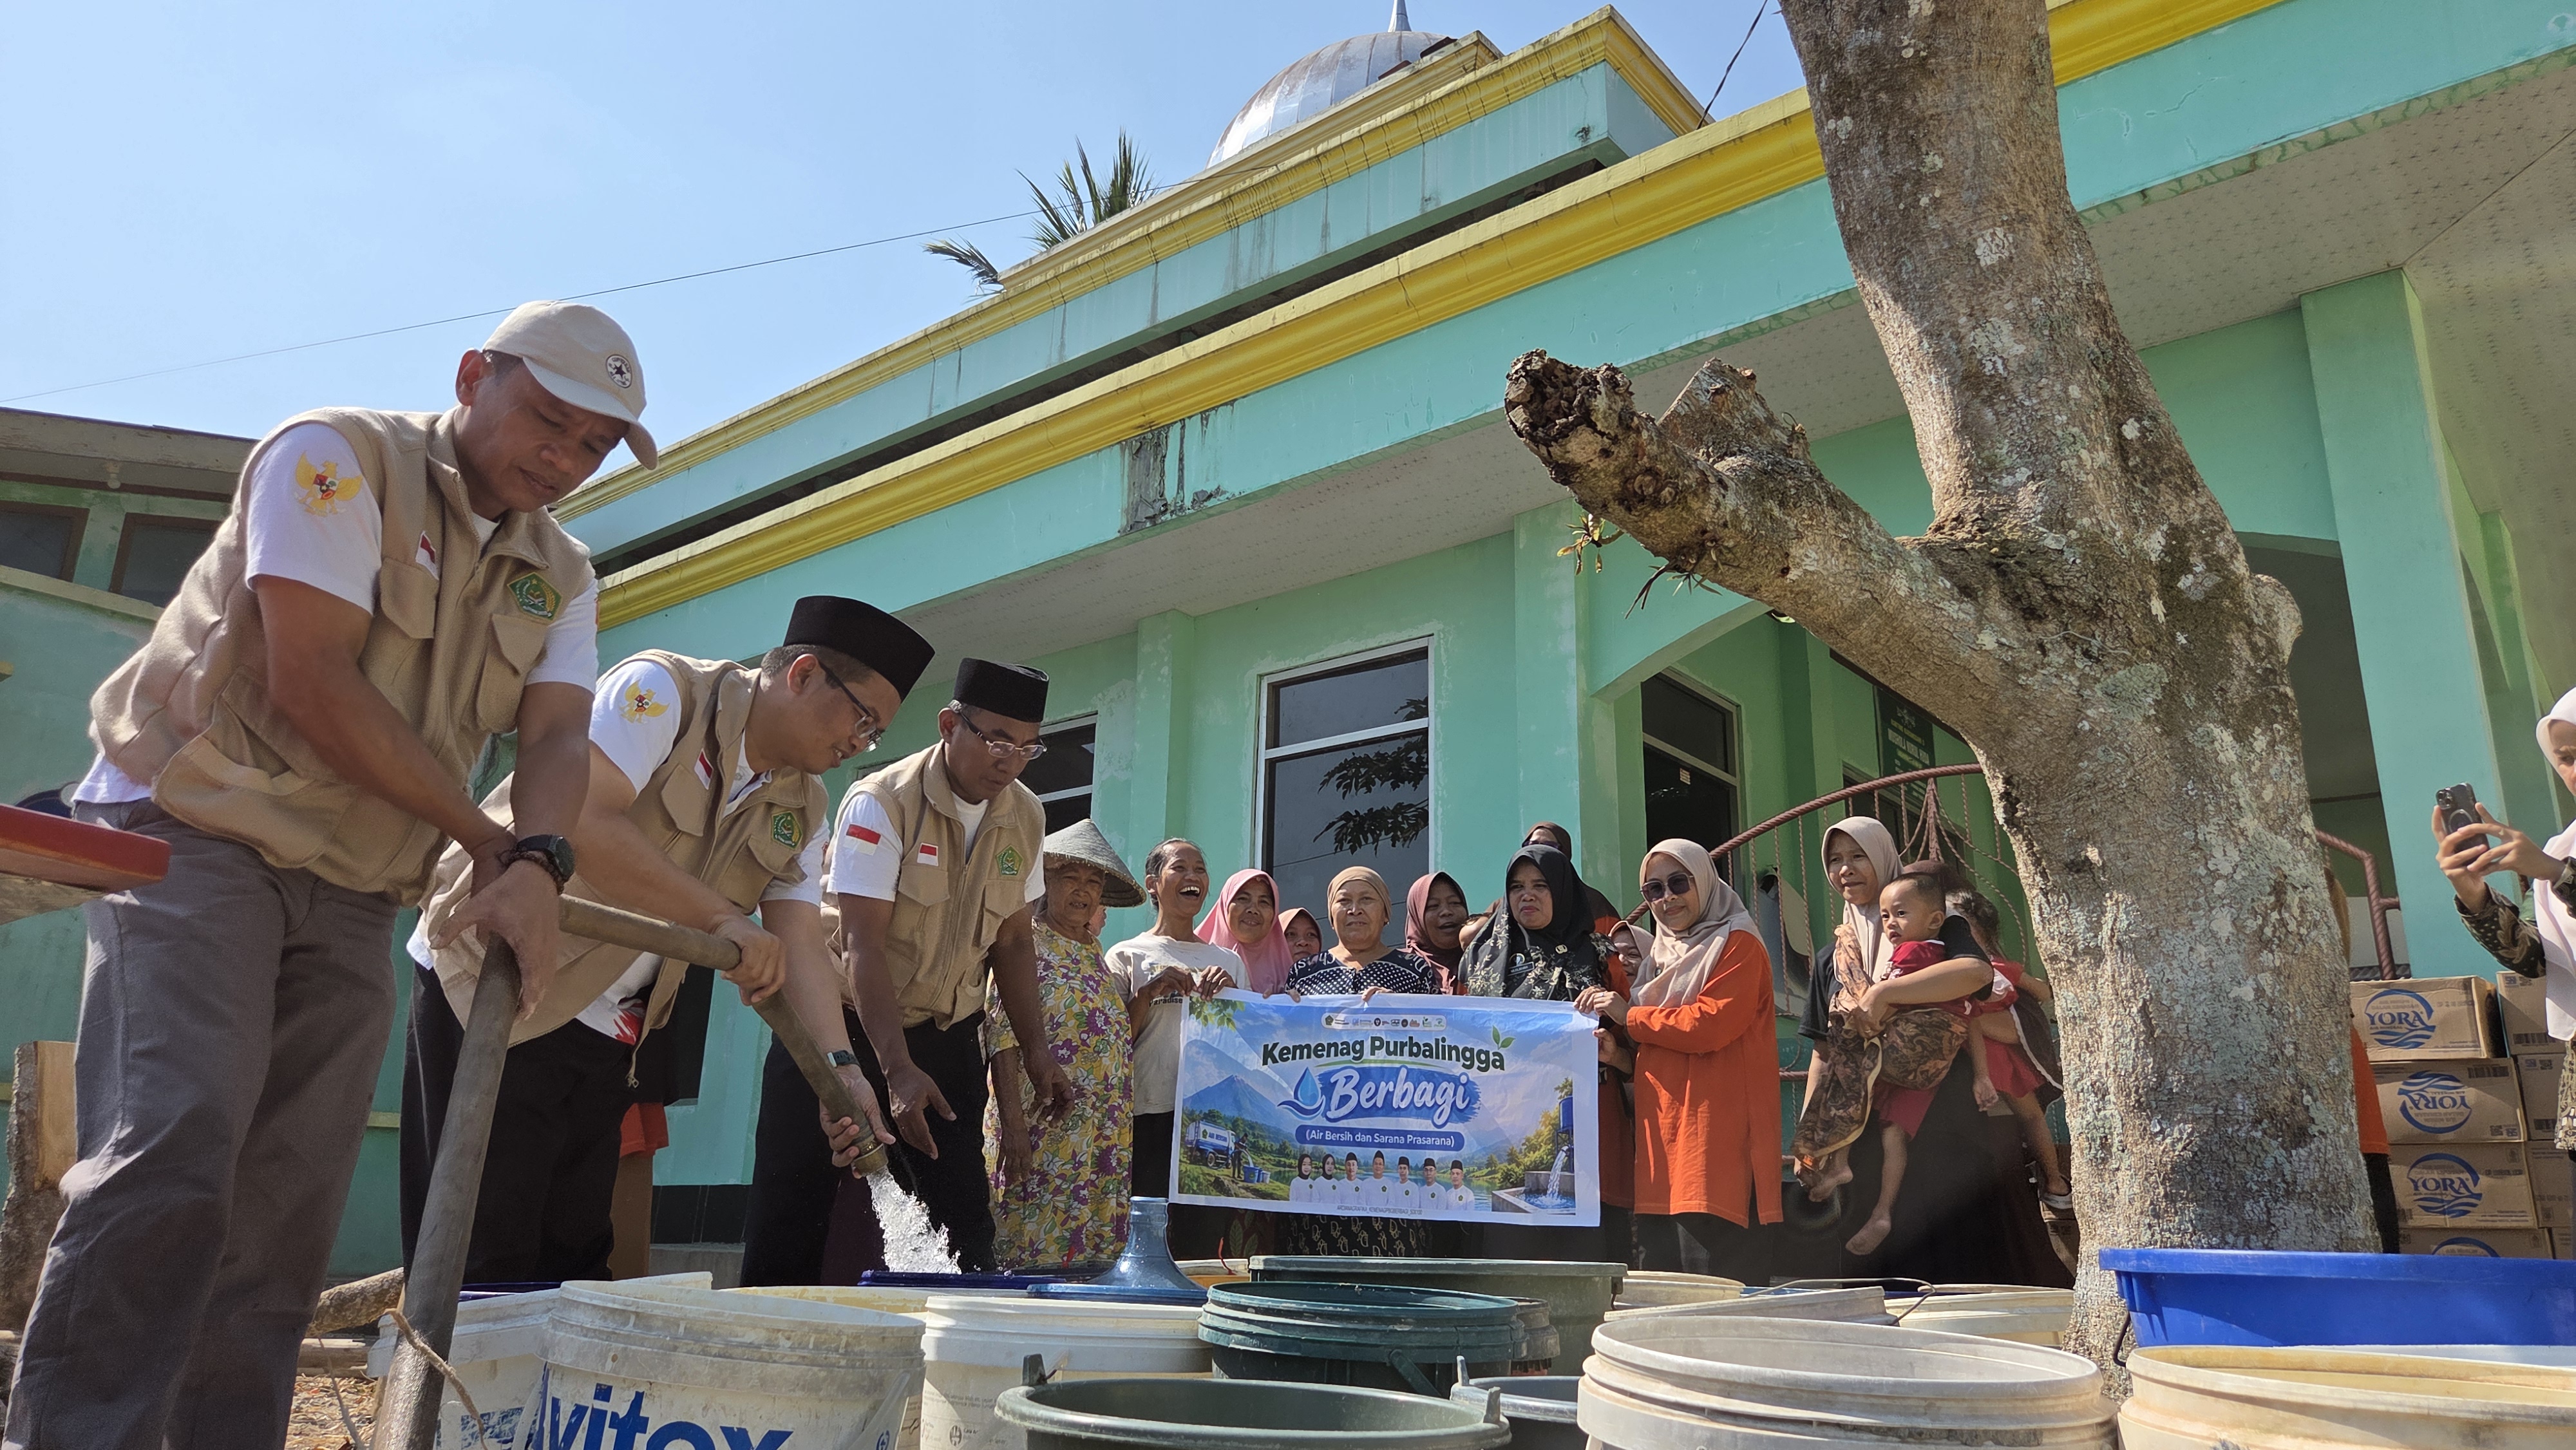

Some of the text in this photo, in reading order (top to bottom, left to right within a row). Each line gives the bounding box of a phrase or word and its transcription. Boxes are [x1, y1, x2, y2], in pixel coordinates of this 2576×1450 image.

[2364, 1010, 2426, 1028] YORA
[1262, 1035, 1506, 1073] Kemenag Purbalingga
[1326, 1067, 1470, 1125] Berbagi
[2408, 1092, 2472, 1111] YORA
[1305, 1131, 1455, 1147] (Air Bersih dan Sarana Prasarana)
[2407, 1176, 2473, 1195] YORA
